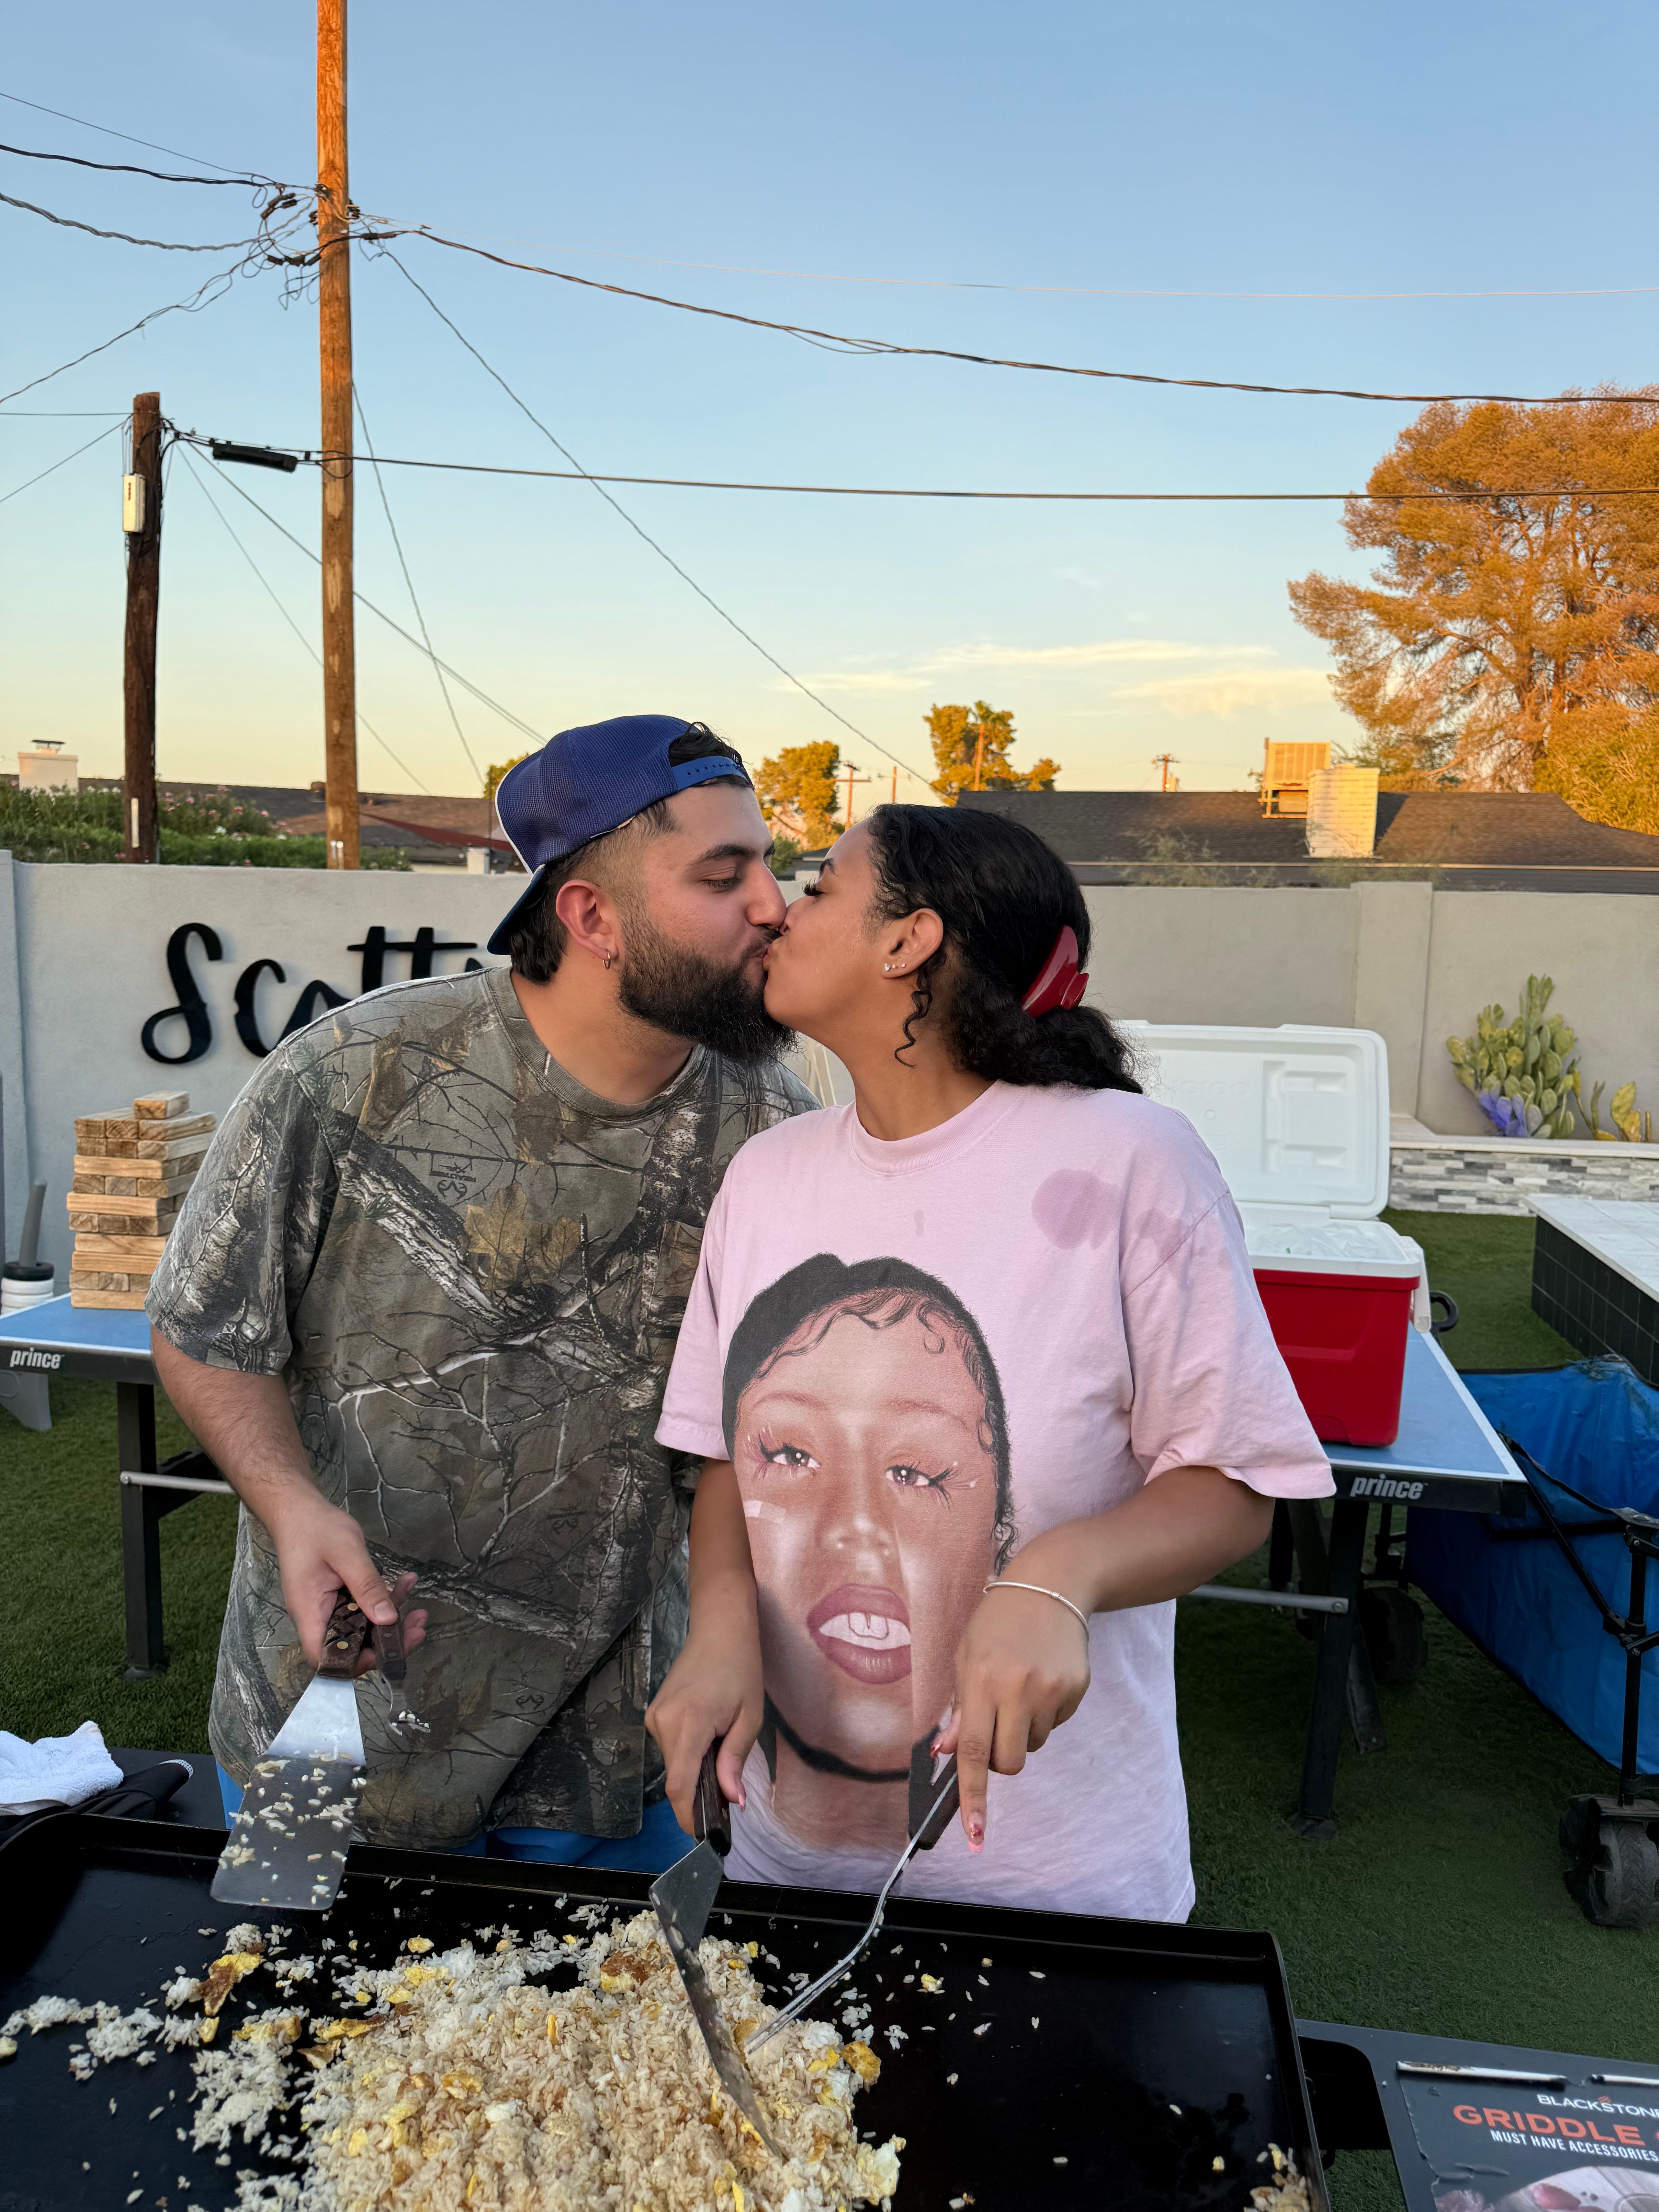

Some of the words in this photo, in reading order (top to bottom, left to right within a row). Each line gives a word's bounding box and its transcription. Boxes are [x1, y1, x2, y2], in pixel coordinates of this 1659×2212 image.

[10, 1346, 61, 1369] prince
[1349, 1473, 1424, 1500] prince
[1453, 2104, 1645, 2146] GRIDDLE
[1490, 2129, 1527, 2146] MUST
[1530, 2135, 1566, 2150] HAVE
[1569, 2140, 1659, 2162] ACCESSORIES
